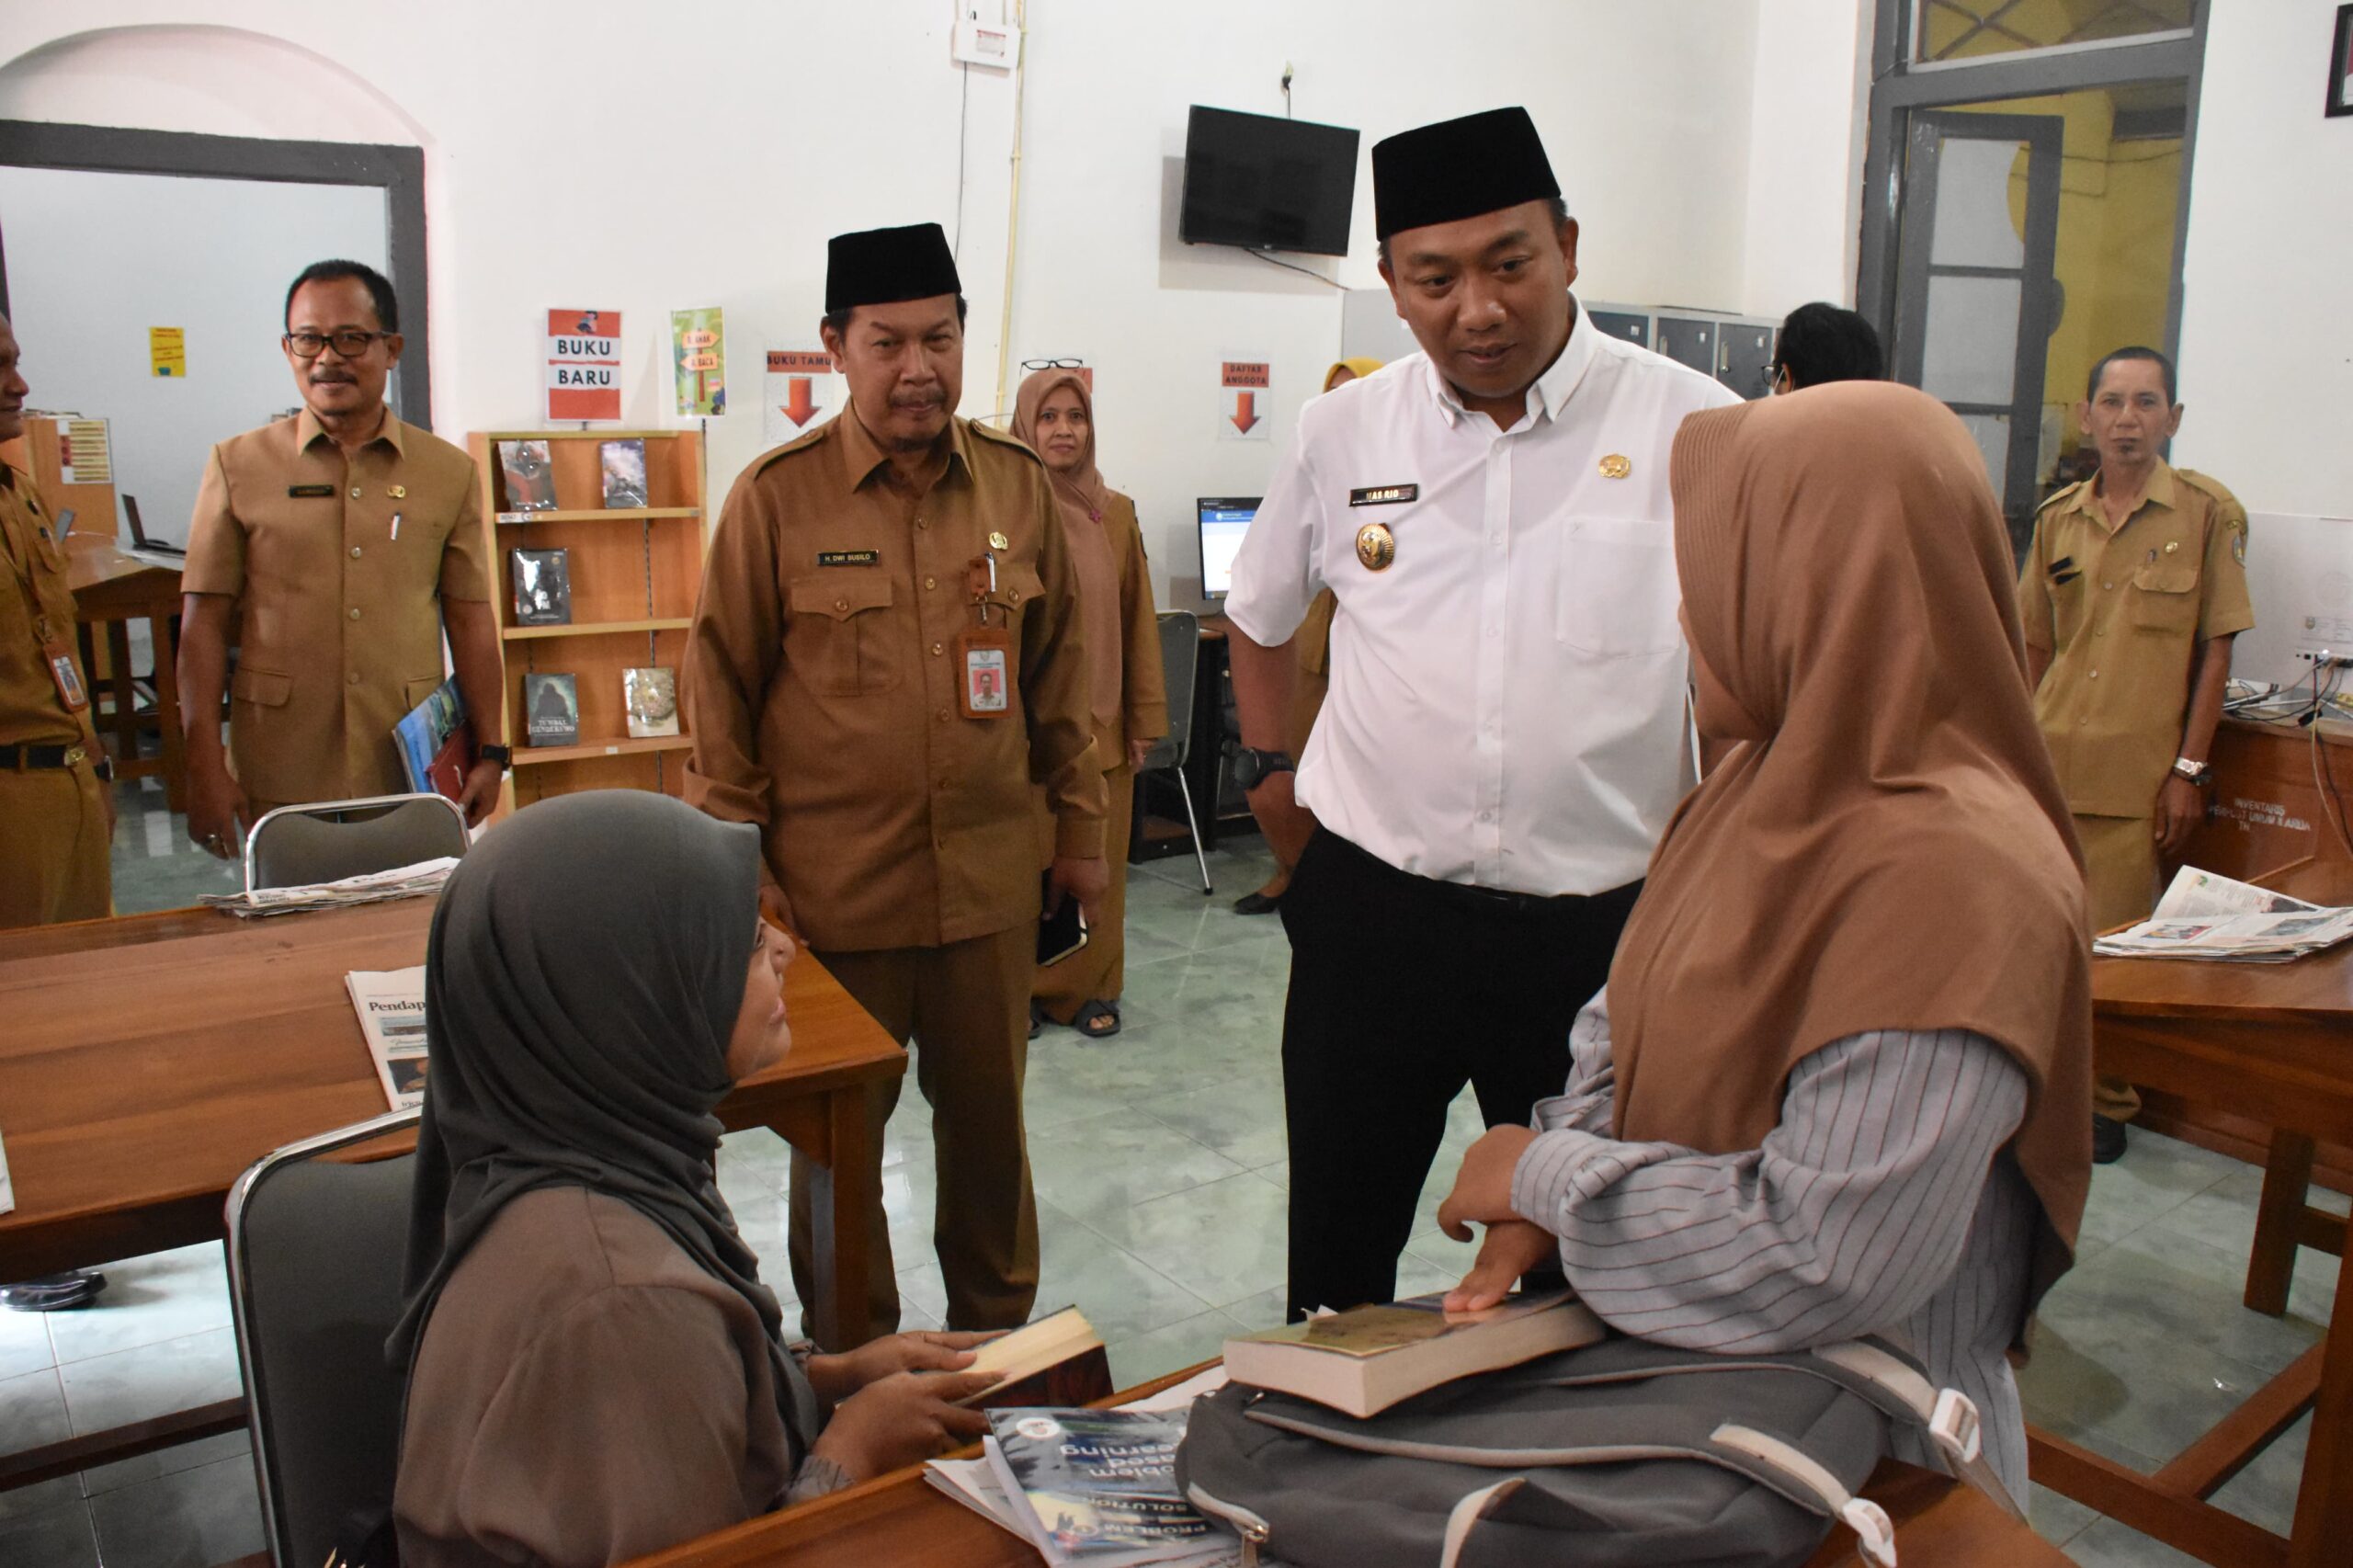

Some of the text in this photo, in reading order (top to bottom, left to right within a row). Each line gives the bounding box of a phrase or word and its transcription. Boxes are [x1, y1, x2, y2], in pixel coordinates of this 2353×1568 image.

[557, 339, 610, 356] BUKU
[767, 355, 831, 366] BUKU TAMU
[558, 369, 610, 385] BARU
[1225, 376, 1267, 384] ANGGOTA
[1383, 489, 1399, 499] RIO
[369, 1000, 426, 1012] Pendap
[1060, 1443, 1176, 1459] earning
[1108, 1454, 1176, 1468] ased
[1088, 1465, 1175, 1478] oblem
[1103, 1523, 1207, 1536] PROBLEM
